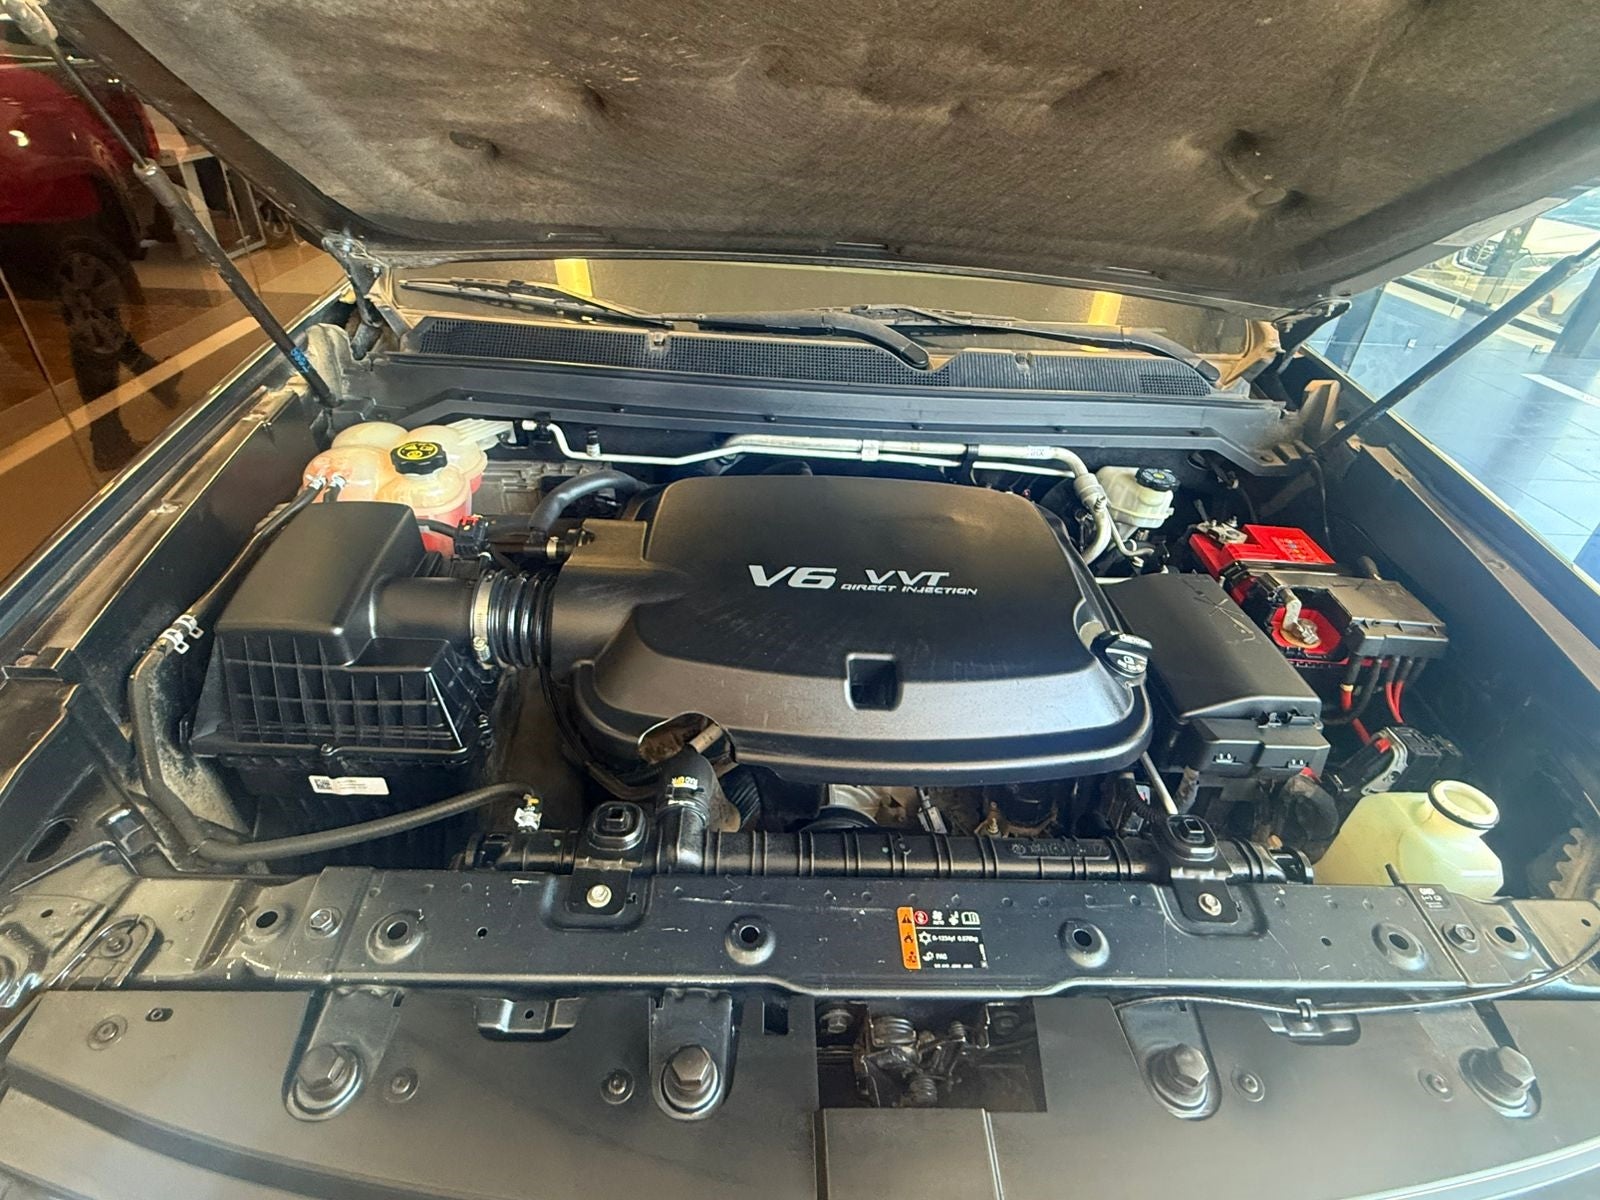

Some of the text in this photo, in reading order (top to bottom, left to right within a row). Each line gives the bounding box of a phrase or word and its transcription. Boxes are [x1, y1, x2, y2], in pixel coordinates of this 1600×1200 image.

[748, 565, 950, 589] V6 VVT
[841, 583, 978, 595] DIRECT INJECTION
